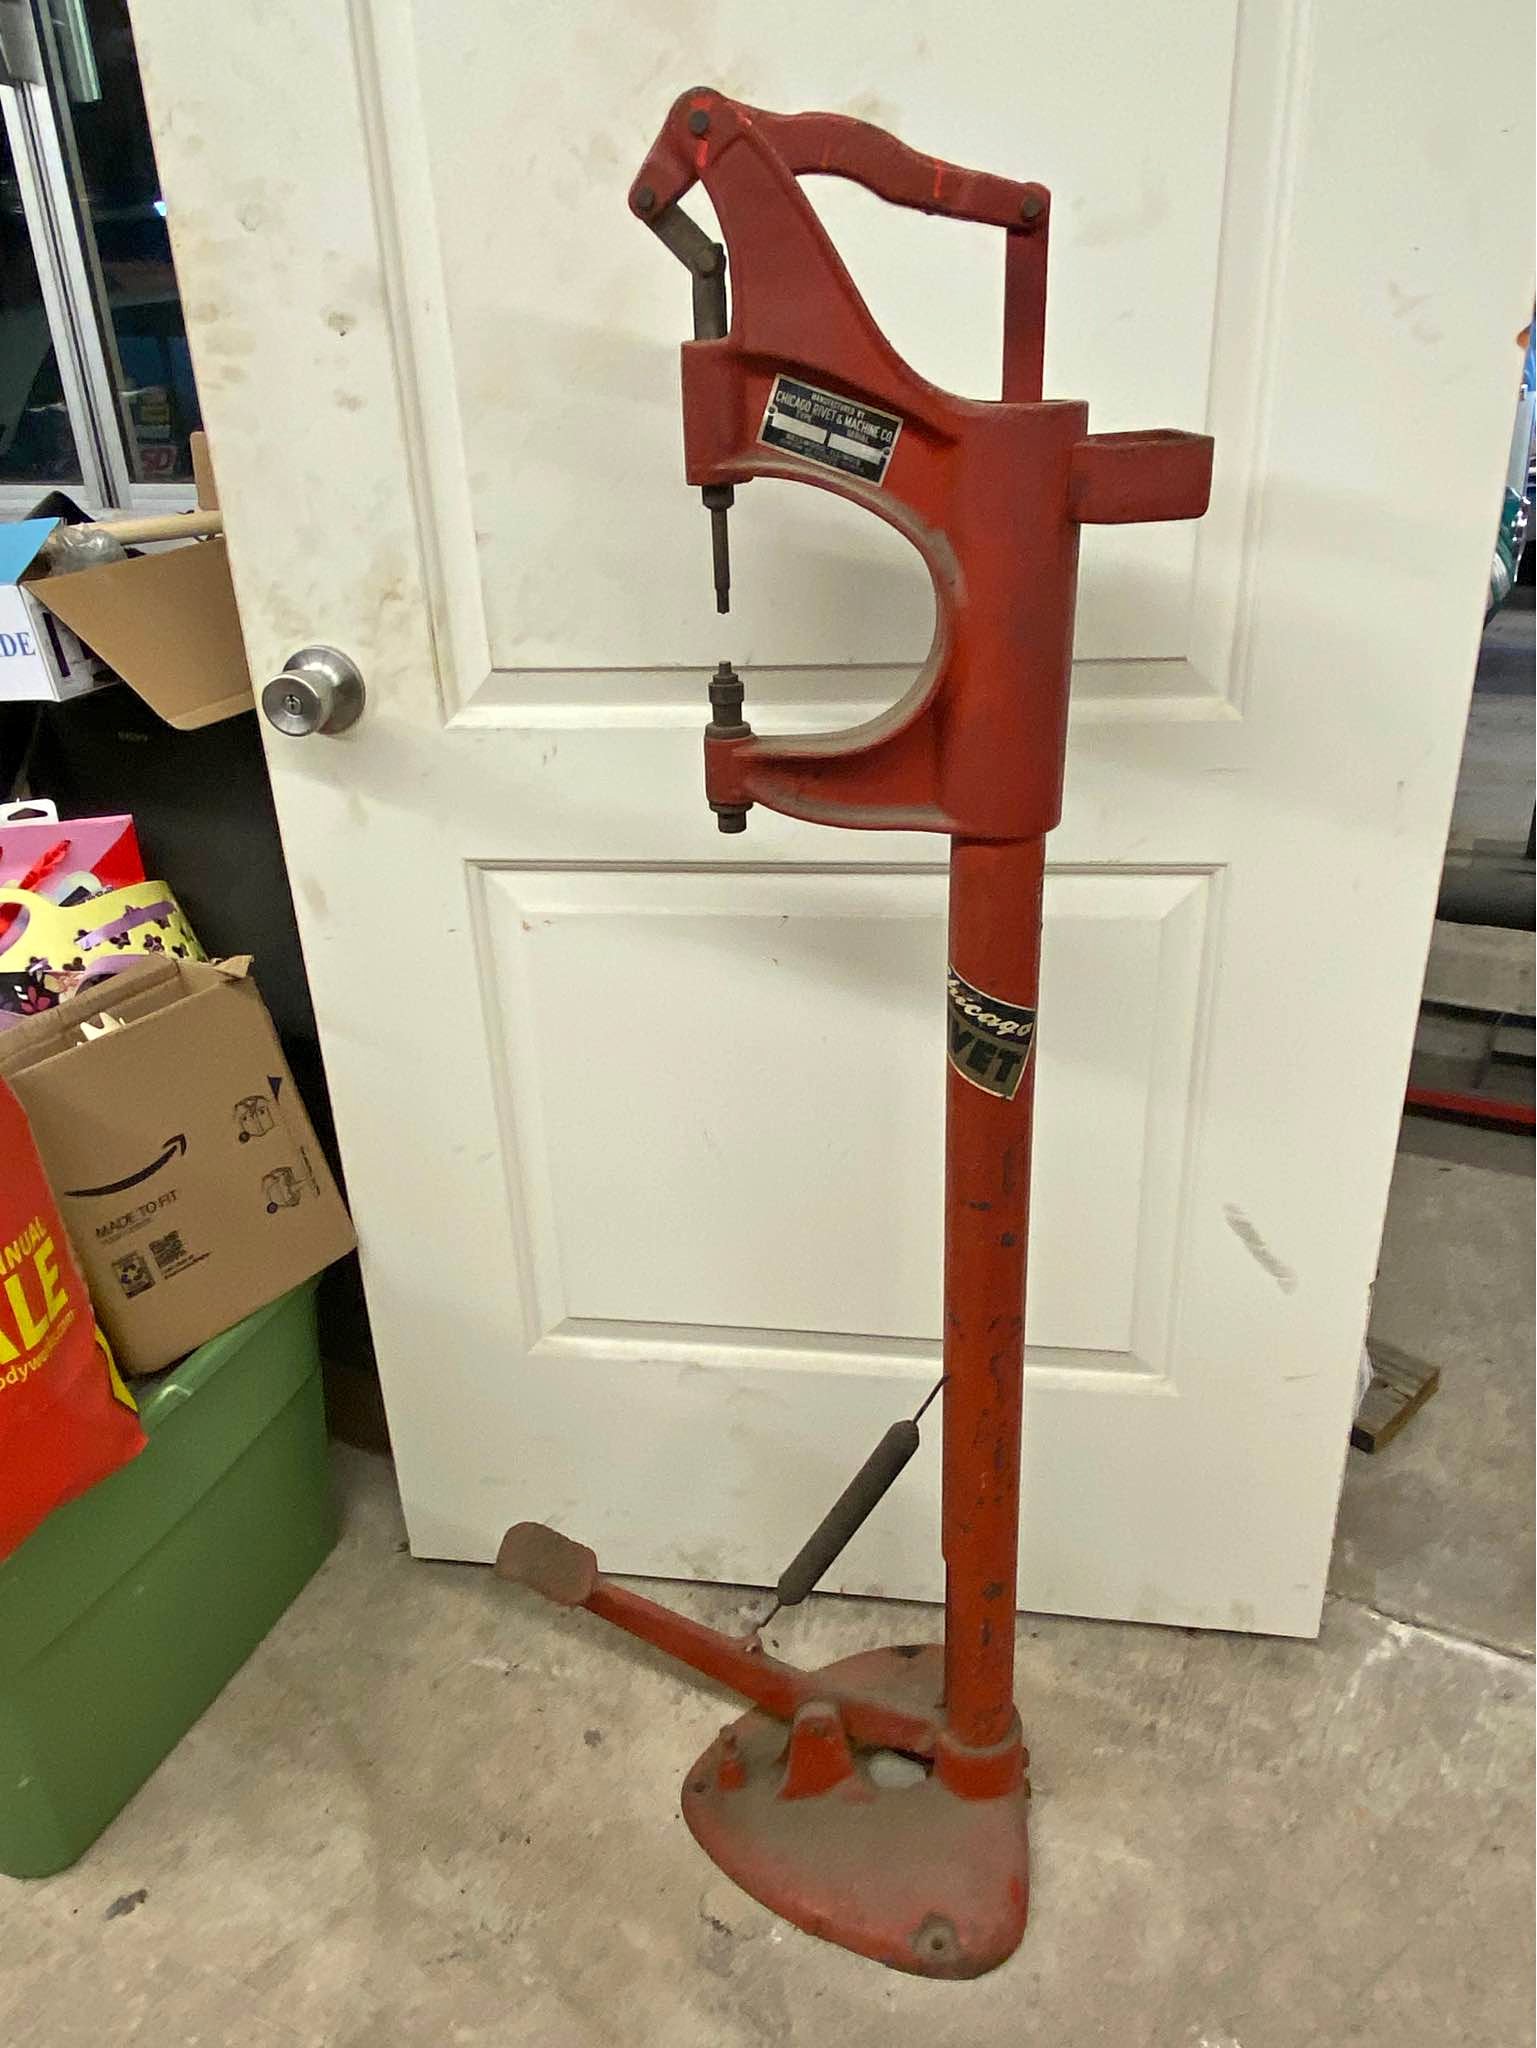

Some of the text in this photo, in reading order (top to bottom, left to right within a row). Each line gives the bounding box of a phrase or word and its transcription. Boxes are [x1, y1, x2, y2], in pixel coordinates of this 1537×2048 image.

[775, 390, 812, 412] CHICAGO
[812, 403, 838, 422] RIVET
[836, 413, 843, 425] &
[843, 414, 881, 439] MACHINE
[95, 1211, 138, 1239] MADE
[136, 1201, 157, 1217] TO
[158, 1189, 177, 1208] FIT
